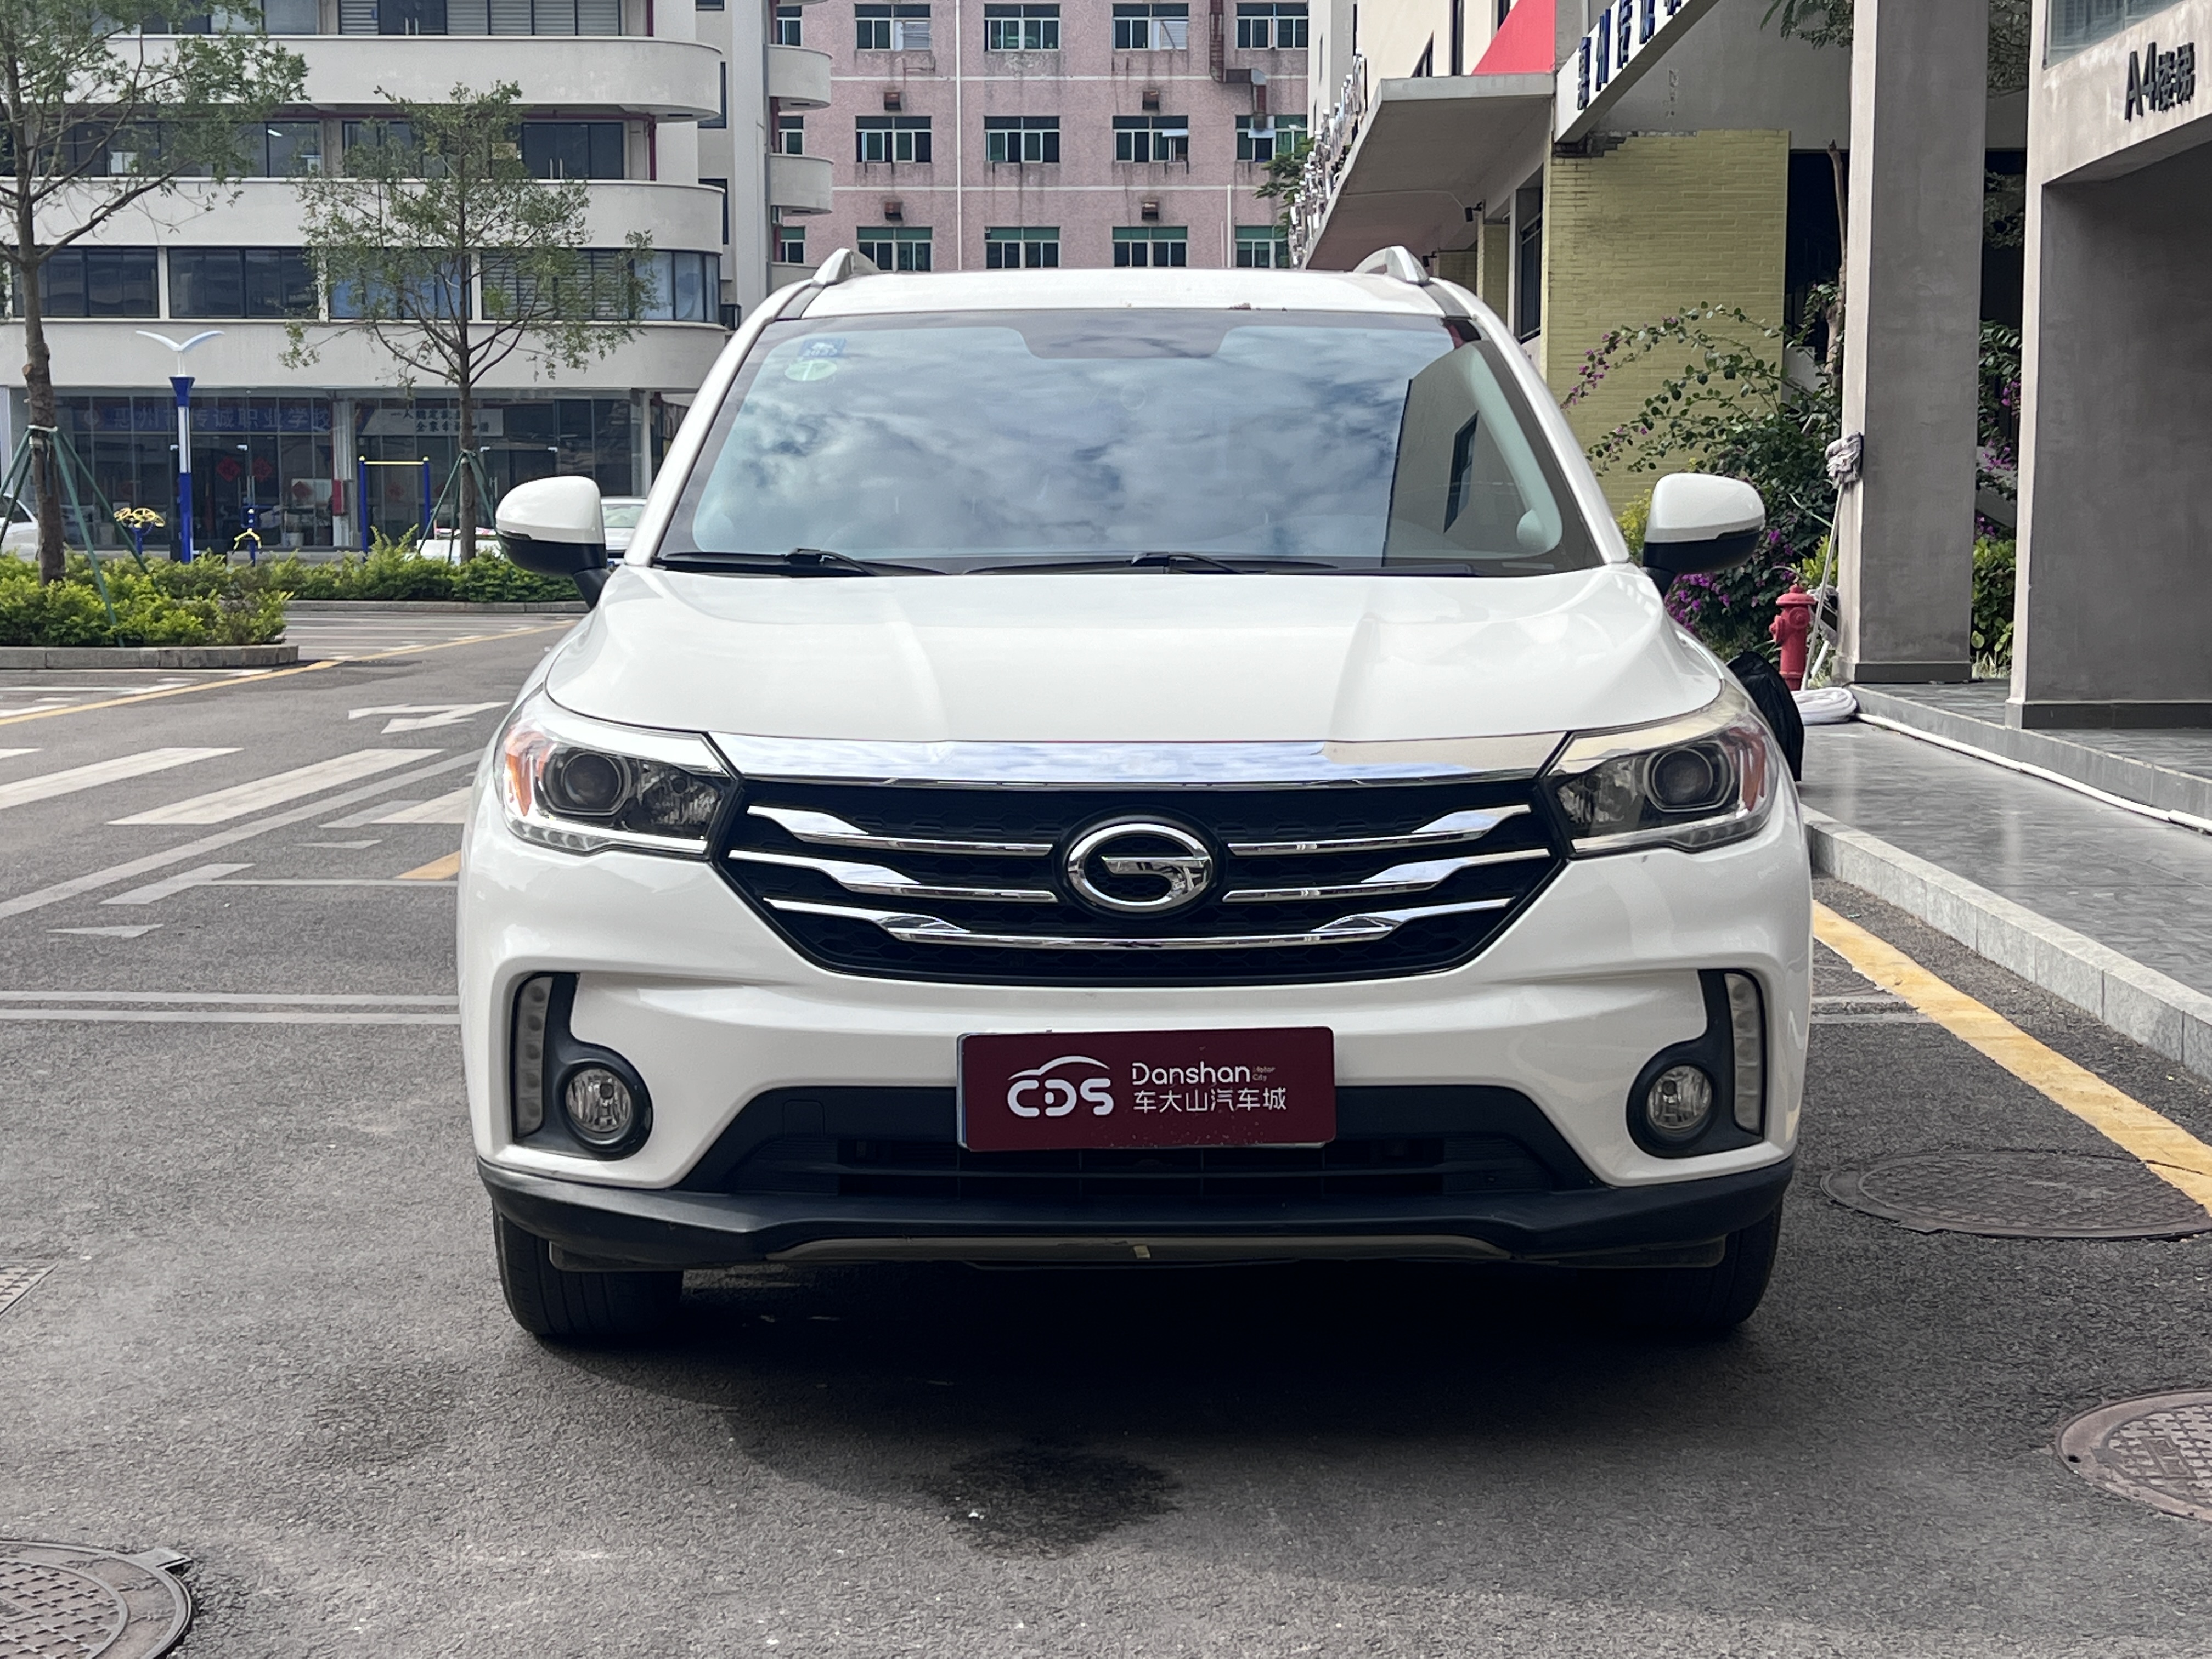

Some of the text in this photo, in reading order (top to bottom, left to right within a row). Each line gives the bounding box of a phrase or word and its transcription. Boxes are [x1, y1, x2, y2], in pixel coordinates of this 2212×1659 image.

[1131, 1060, 1250, 1085] Danshan
[1007, 1077, 1114, 1118] CDS
[1133, 1087, 1287, 1114] 车大山汽车城
